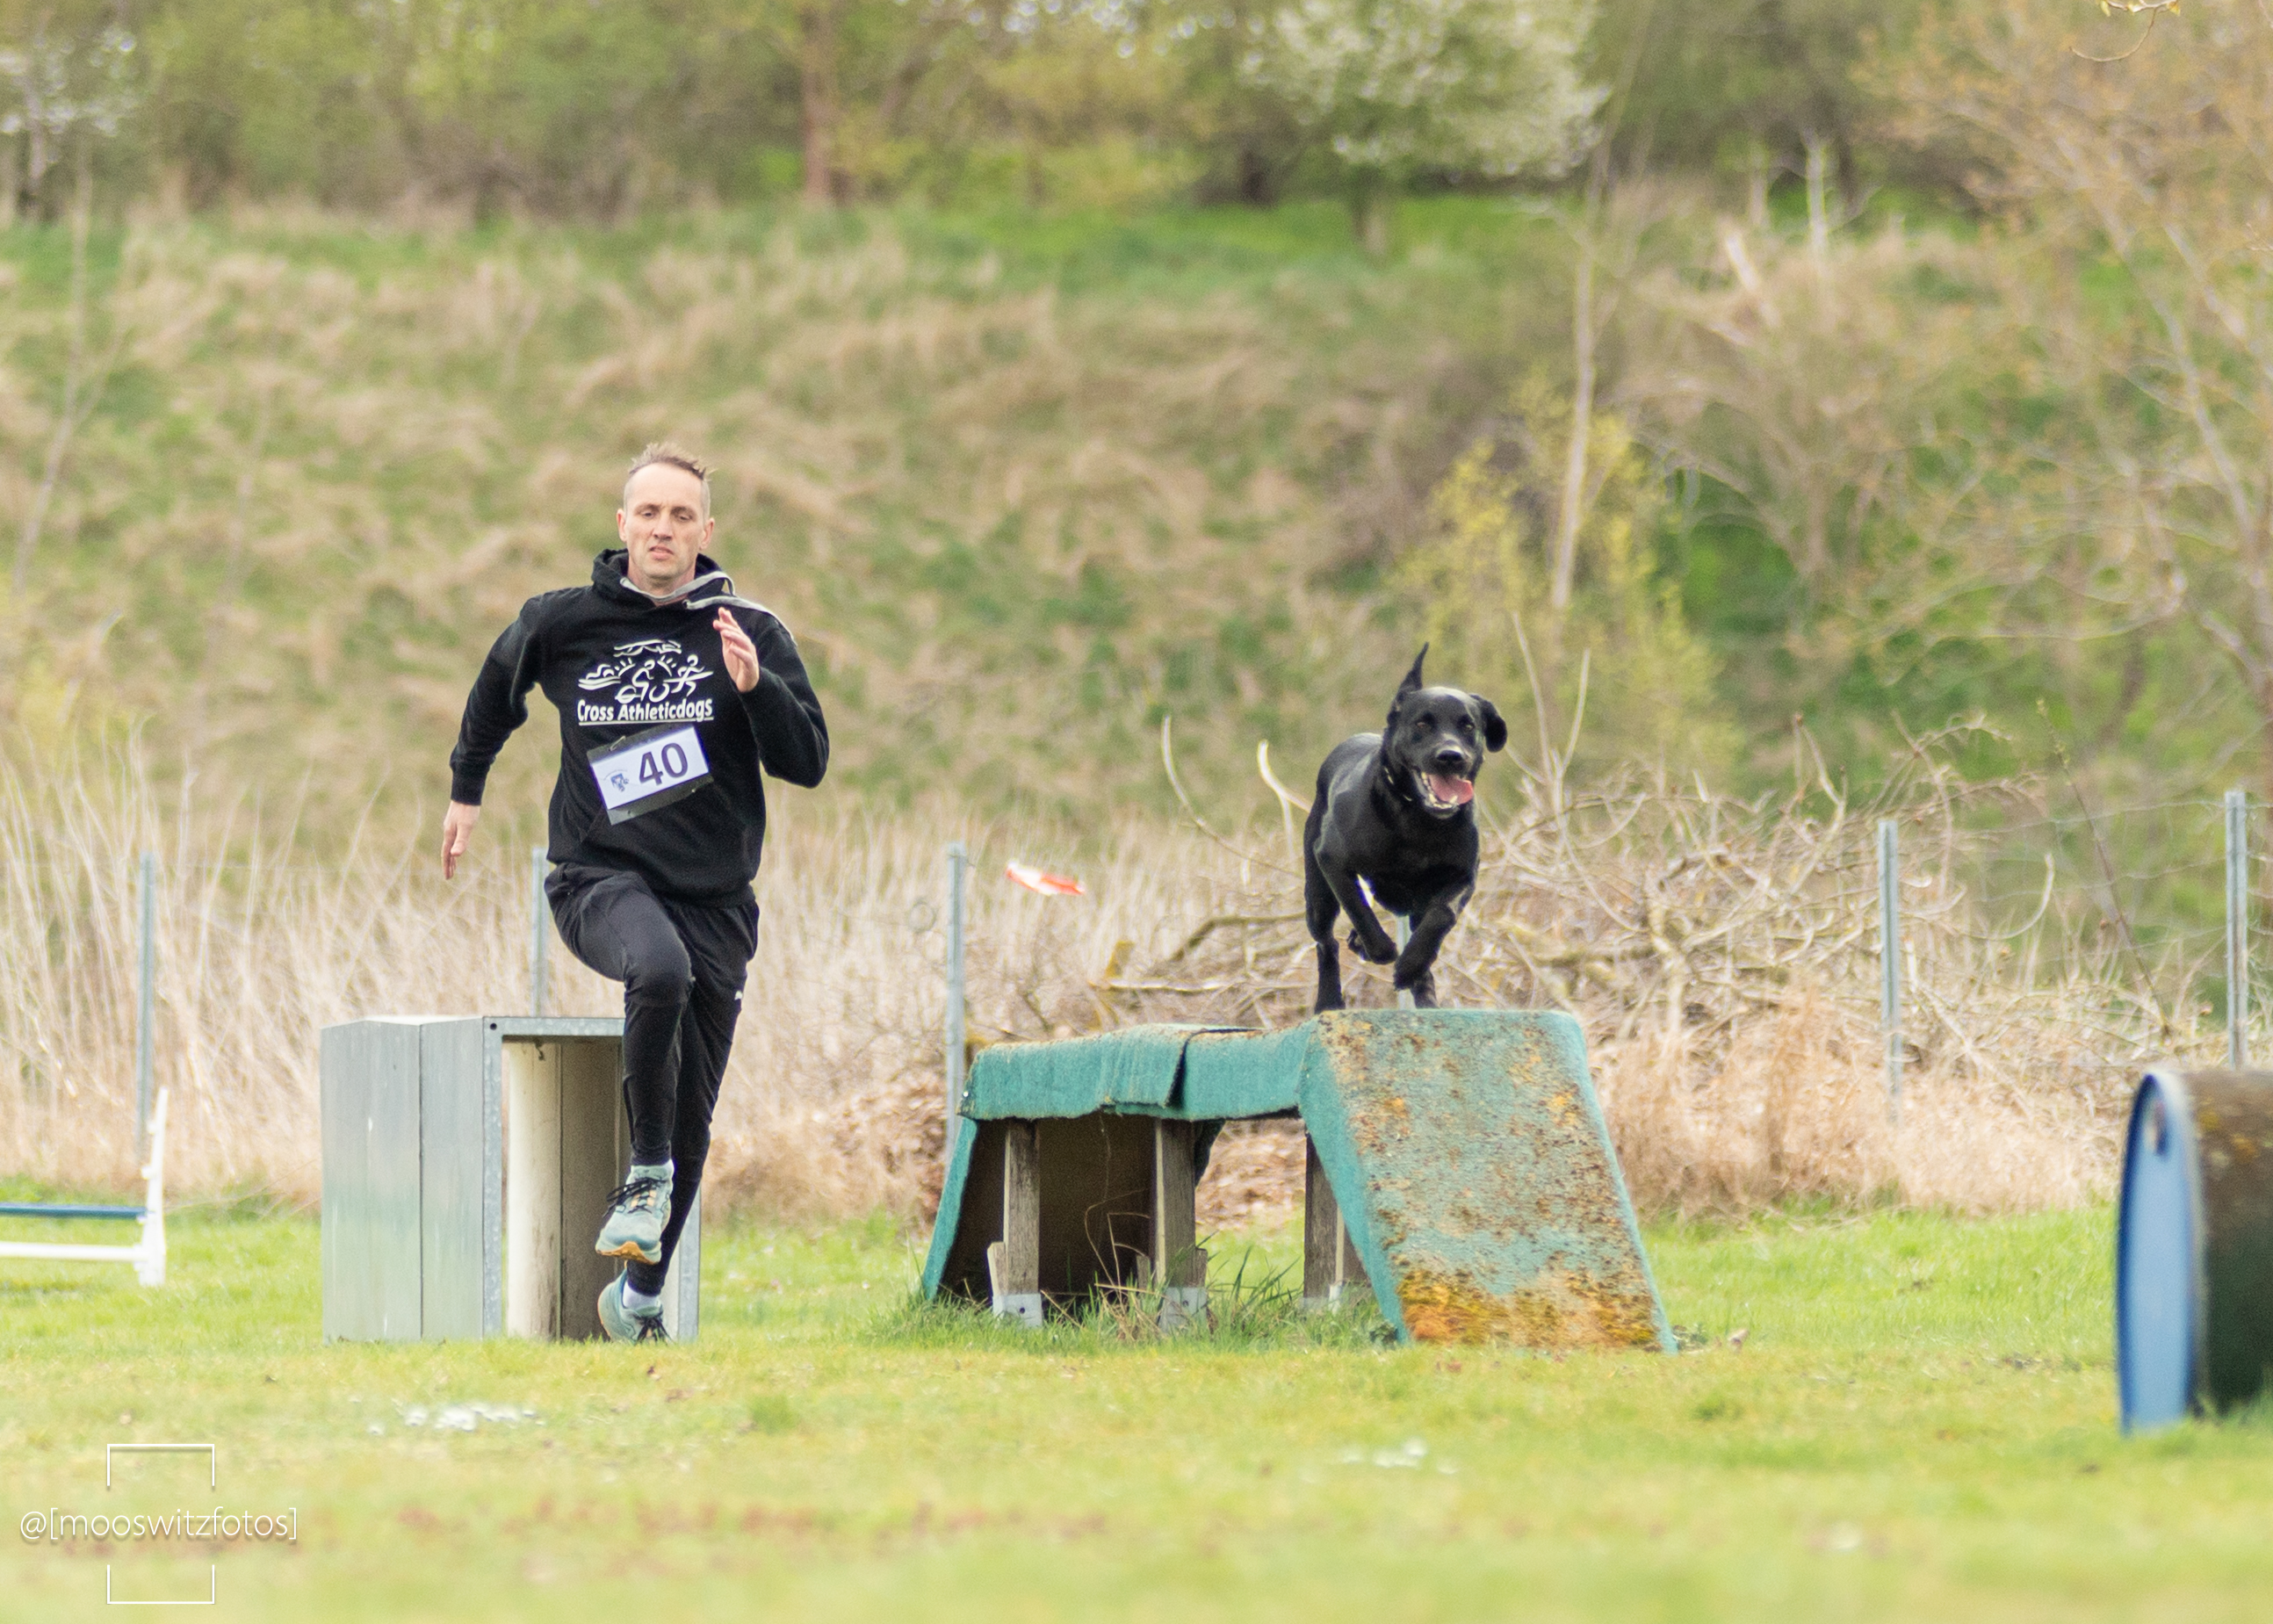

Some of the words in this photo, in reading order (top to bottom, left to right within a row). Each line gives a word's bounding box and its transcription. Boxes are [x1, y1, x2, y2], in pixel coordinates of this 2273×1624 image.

[577, 699, 614, 721] Cross
[617, 698, 712, 722] Athleticdogs
[639, 742, 689, 786] 40
